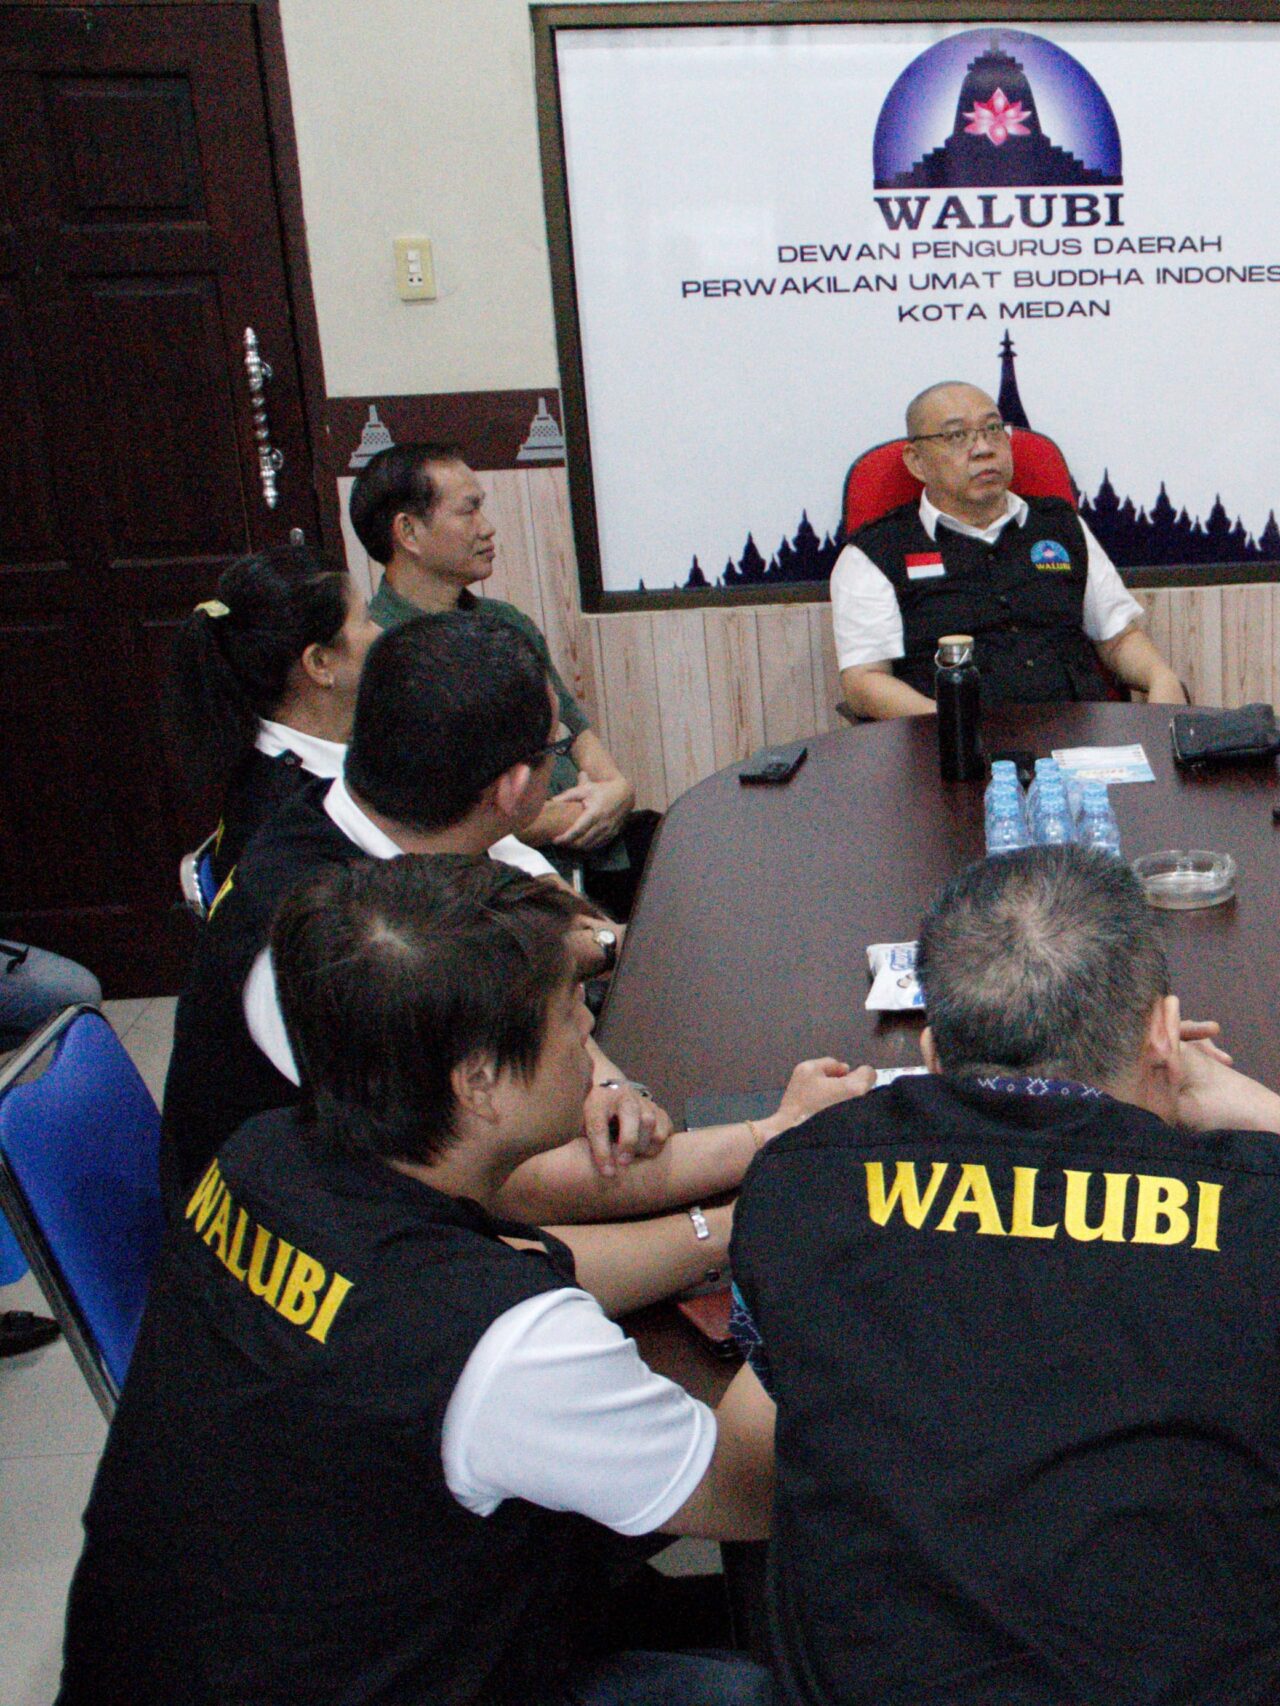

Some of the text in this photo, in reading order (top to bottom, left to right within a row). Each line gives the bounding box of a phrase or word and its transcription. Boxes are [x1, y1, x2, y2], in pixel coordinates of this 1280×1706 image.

[873, 193, 1125, 231] WALUBI
[778, 236, 1222, 263] DEWAN PENGURUS DAERAH
[682, 274, 897, 298] PERWAKILAN
[909, 271, 1000, 291] UMAT
[1014, 269, 1144, 288] BUDDHA
[898, 300, 1111, 322] KOTA MEDAN
[863, 1160, 1224, 1252] WALUBI
[186, 1157, 354, 1344] WALUBI
